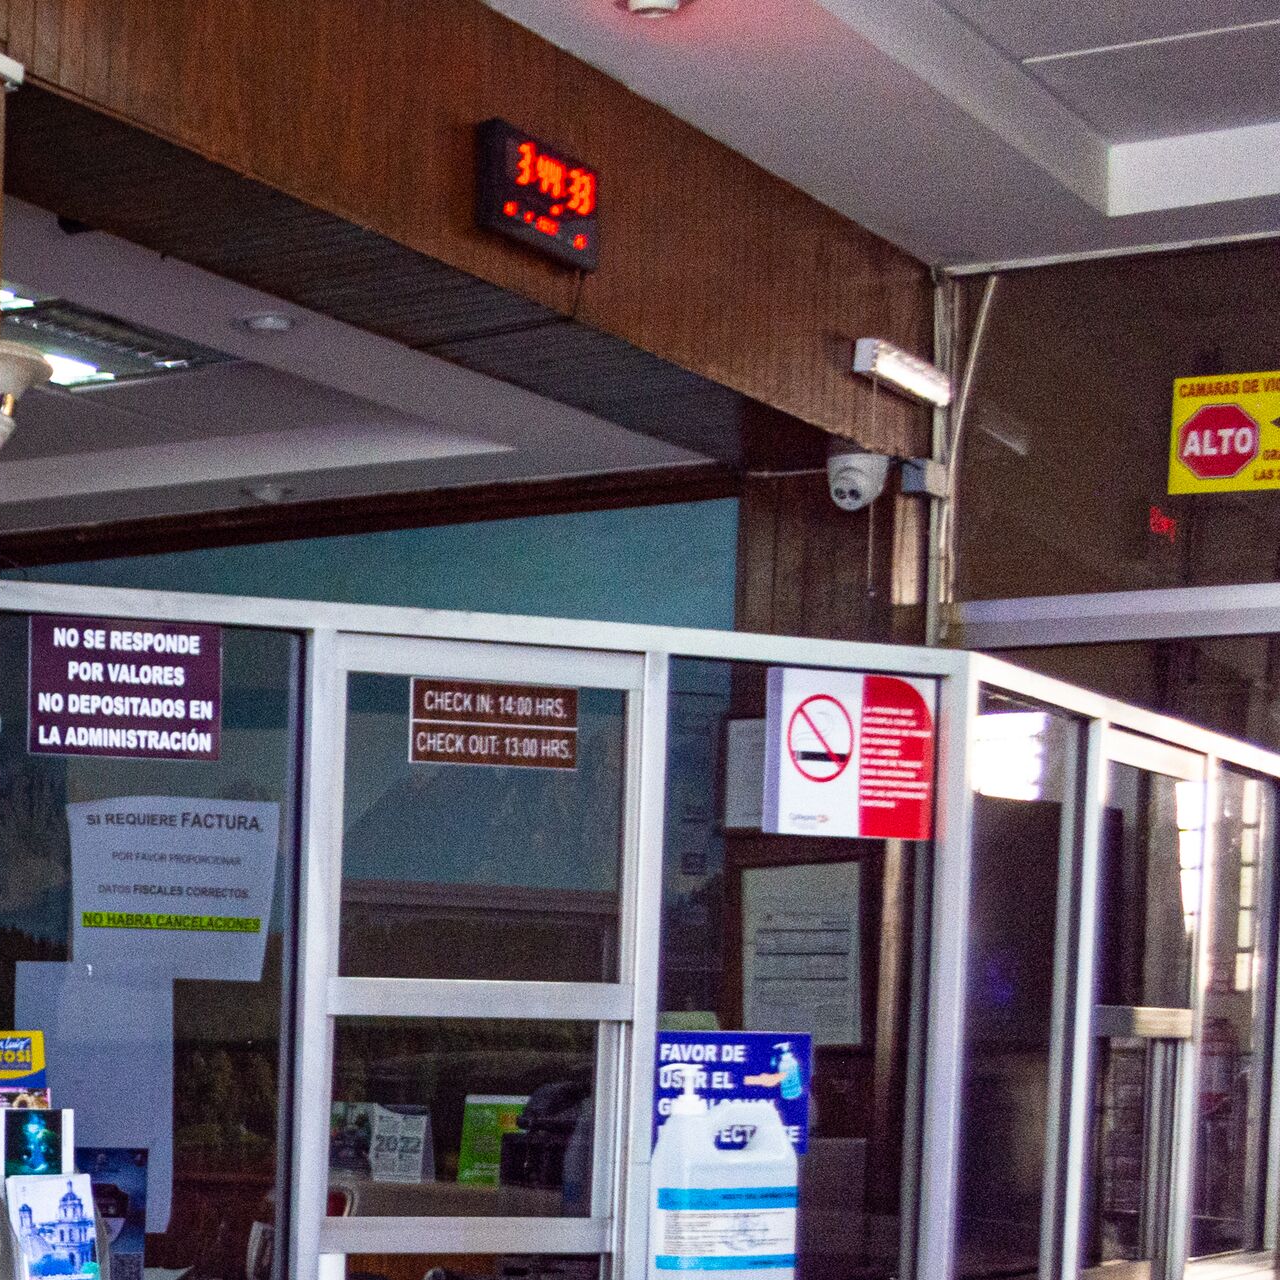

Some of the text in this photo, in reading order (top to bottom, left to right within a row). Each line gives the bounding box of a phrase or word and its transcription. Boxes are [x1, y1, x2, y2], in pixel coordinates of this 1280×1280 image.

[1242, 379, 1259, 394] DE
[1182, 427, 1253, 457] ALTO
[53, 627, 200, 655] NO SE RESPONDE
[68, 661, 185, 686] POR VALORES
[38, 693, 213, 720] NO DEPOSITADOS EN
[424, 690, 472, 712] CHECK
[499, 696, 533, 716] 14:00
[535, 697, 568, 719] HRS.
[39, 725, 212, 752] LA ADMINISTRACIÓN
[416, 731, 465, 752] CHECK
[504, 737, 538, 758] 13:00
[86, 814, 101, 825] SI
[105, 813, 178, 827] REQUIERE
[111, 851, 133, 861] POR
[135, 852, 167, 863] FAVOR
[133, 885, 183, 897] FISCALES
[83, 912, 260, 931] NO HABRA CANCELACIONES
[660, 1043, 746, 1062] FAVOR DE
[659, 1069, 735, 1089] USR EL
